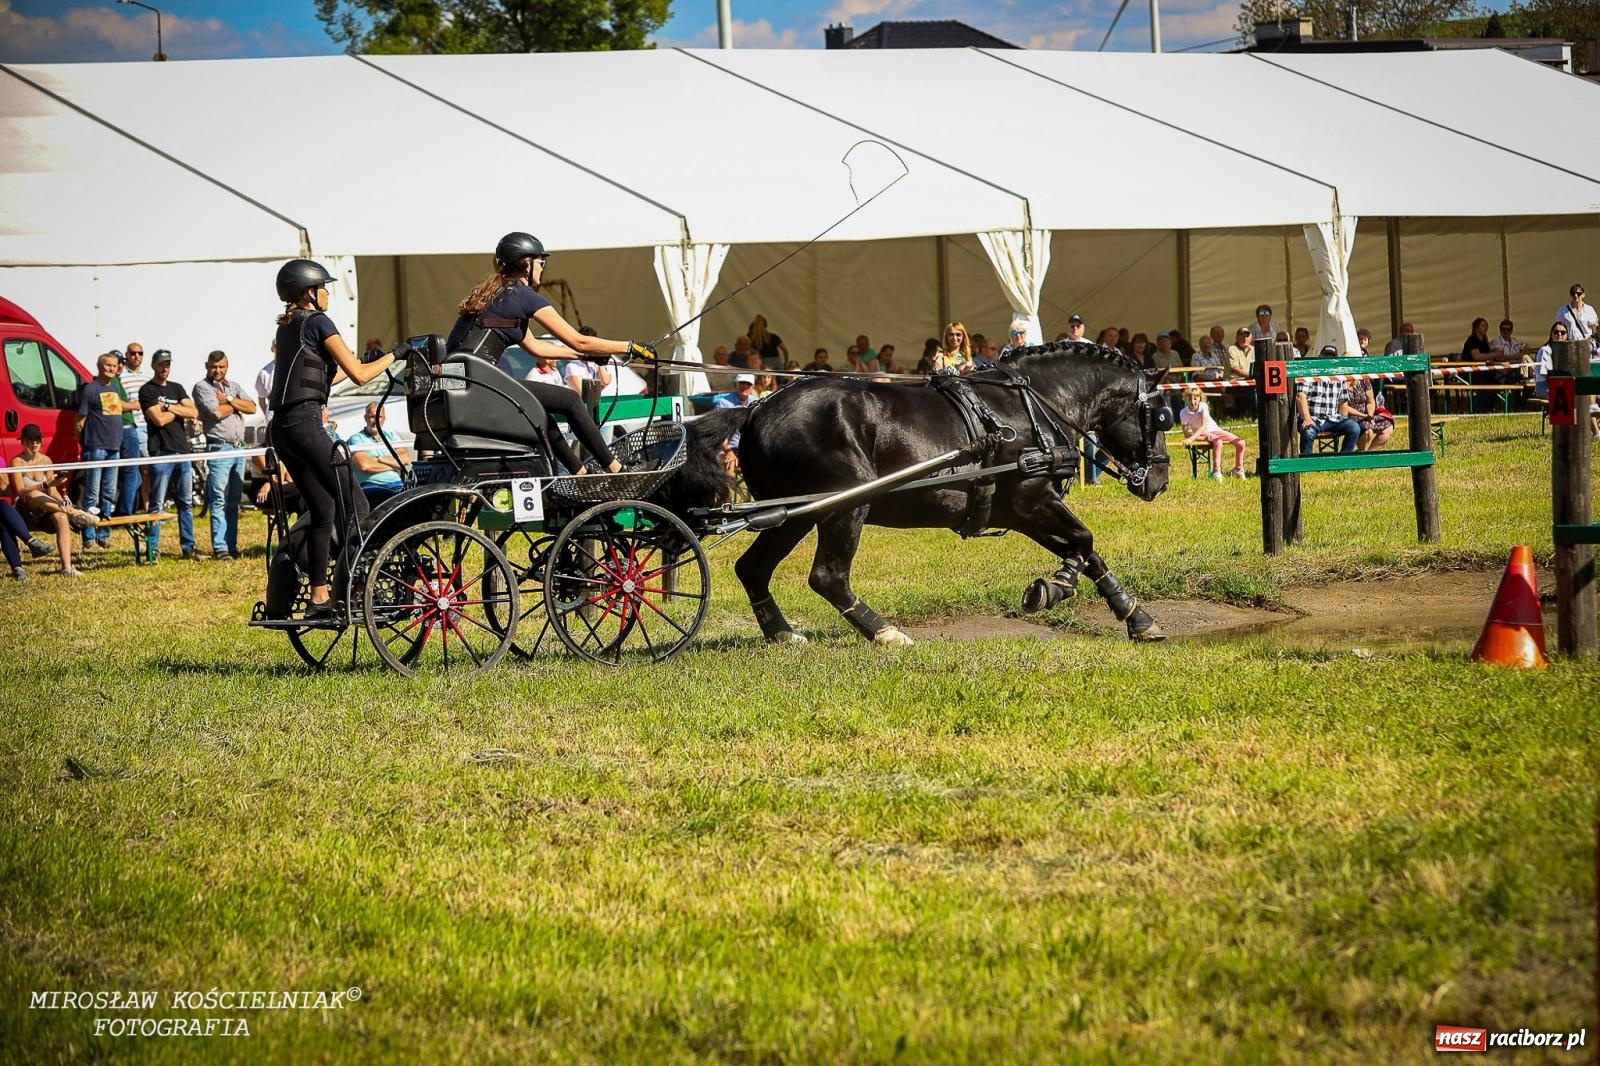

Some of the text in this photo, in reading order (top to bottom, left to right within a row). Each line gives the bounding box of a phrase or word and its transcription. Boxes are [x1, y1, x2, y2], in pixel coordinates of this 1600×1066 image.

[1268, 366, 1282, 387] B
[1551, 385, 1571, 417] A
[523, 496, 535, 511] 6
